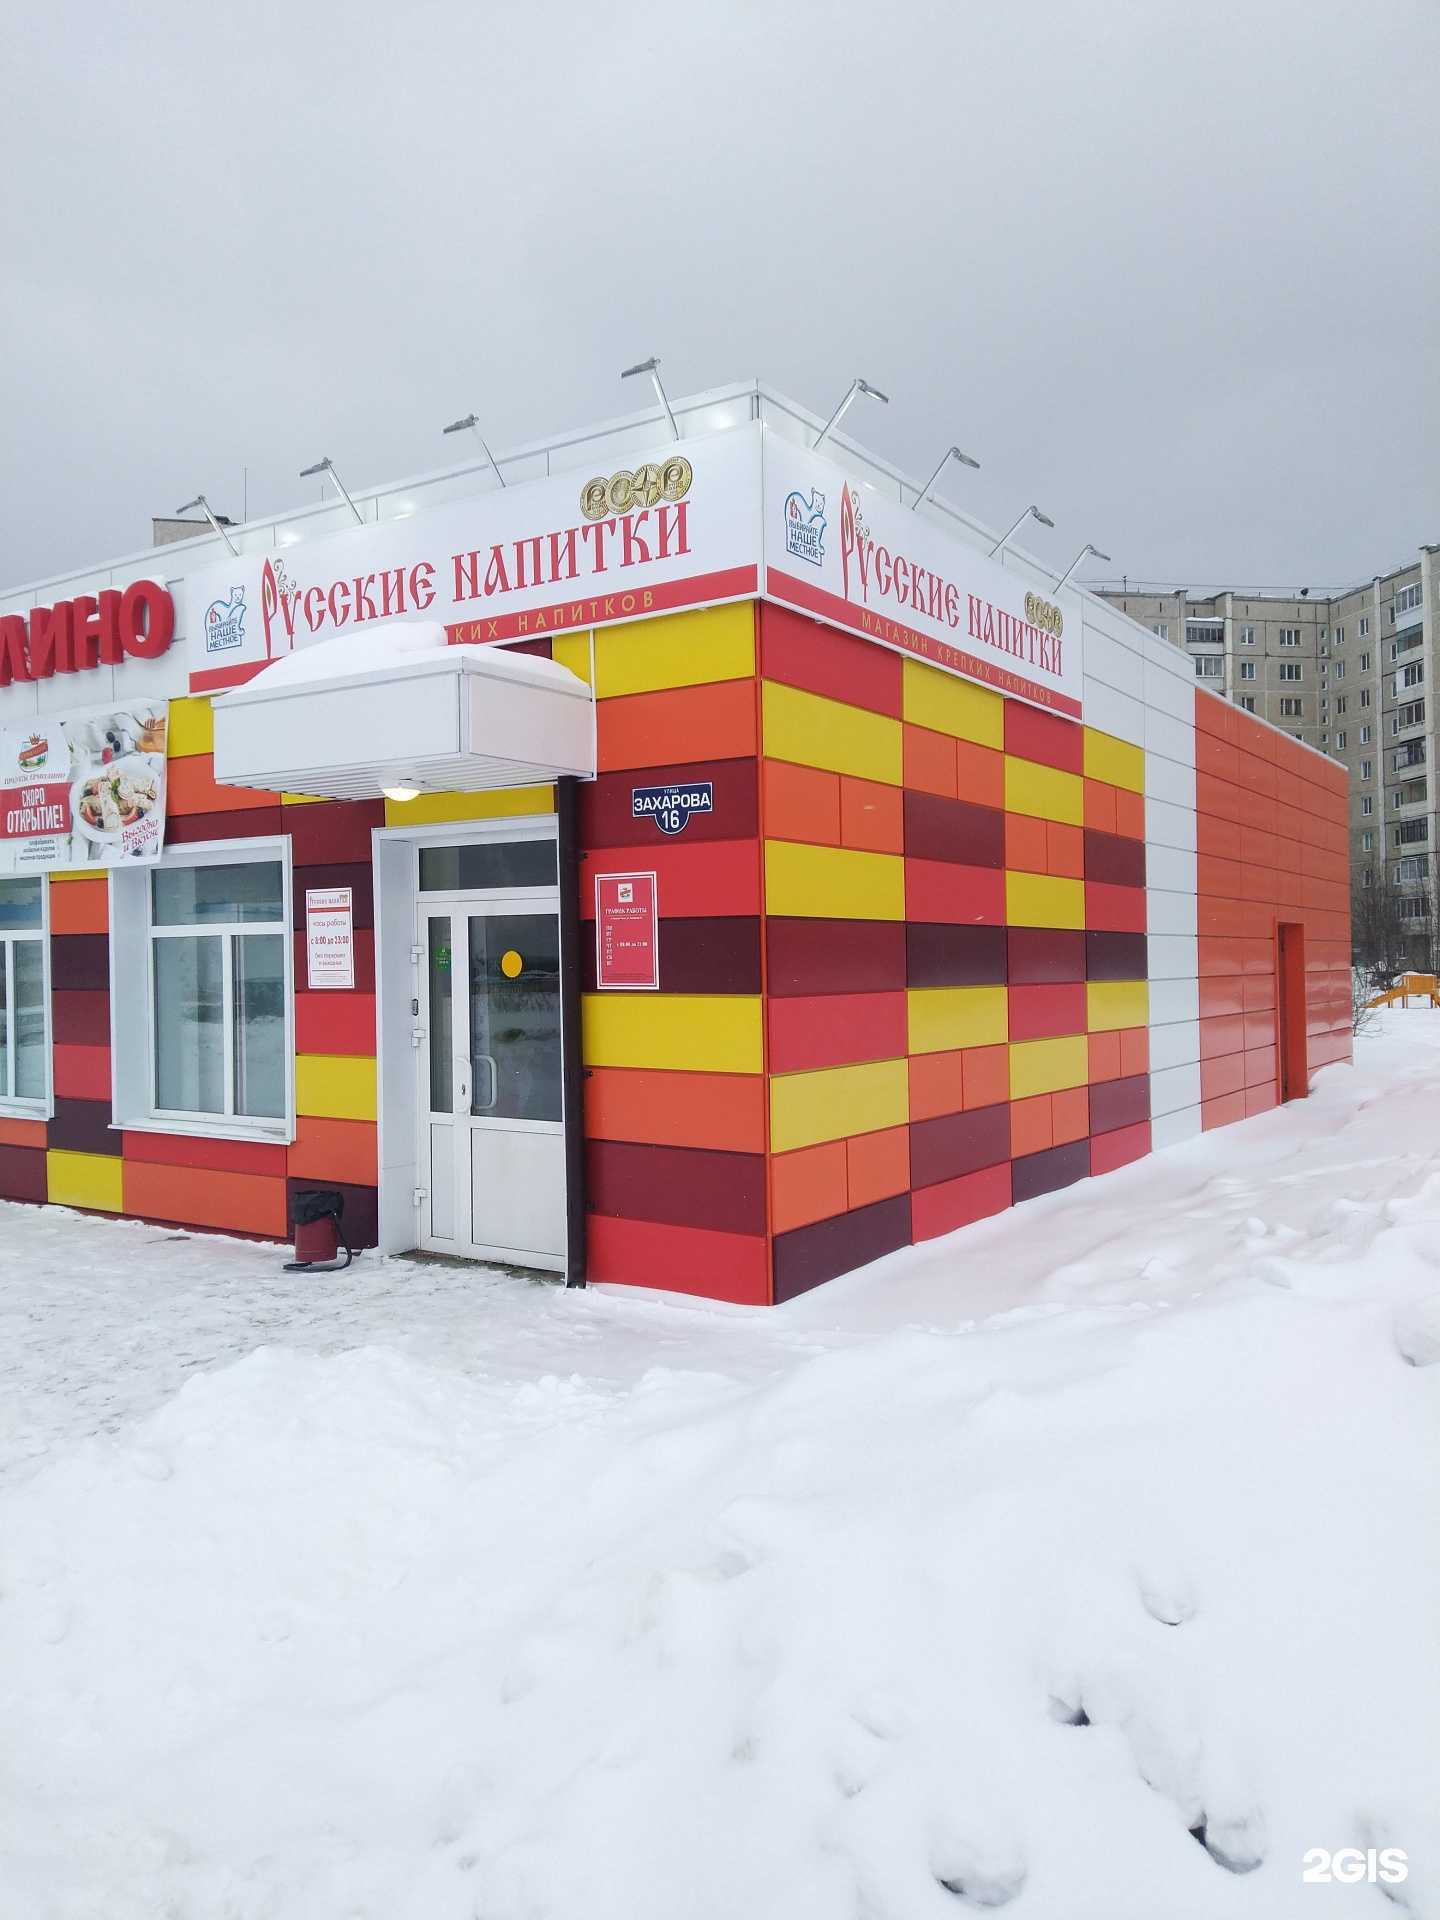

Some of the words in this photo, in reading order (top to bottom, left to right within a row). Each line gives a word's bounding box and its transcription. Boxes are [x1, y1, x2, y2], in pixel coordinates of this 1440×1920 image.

[790, 528, 817, 548] НАШЕ
[451, 500, 692, 602] НАПИТКИ
[789, 540, 819, 559] МЕСТНОЕ
[518, 591, 654, 632] НАПИТКОВ
[209, 634, 239, 650] МЕСТНОЕ
[211, 624, 237, 641] НАШЕ
[967, 593, 1063, 677] НАПИТКИ
[862, 611, 928, 652] МАГАЗИН
[937, 647, 991, 680] КРЕПКИХ
[998, 671, 1051, 704] НАПИТКОВ
[21, 787, 45, 807] СКОРО
[634, 792, 711, 811] ЗАХАРОВА
[6, 804, 64, 833] ОТКРЫТИЕ!
[661, 810, 680, 829] 16
